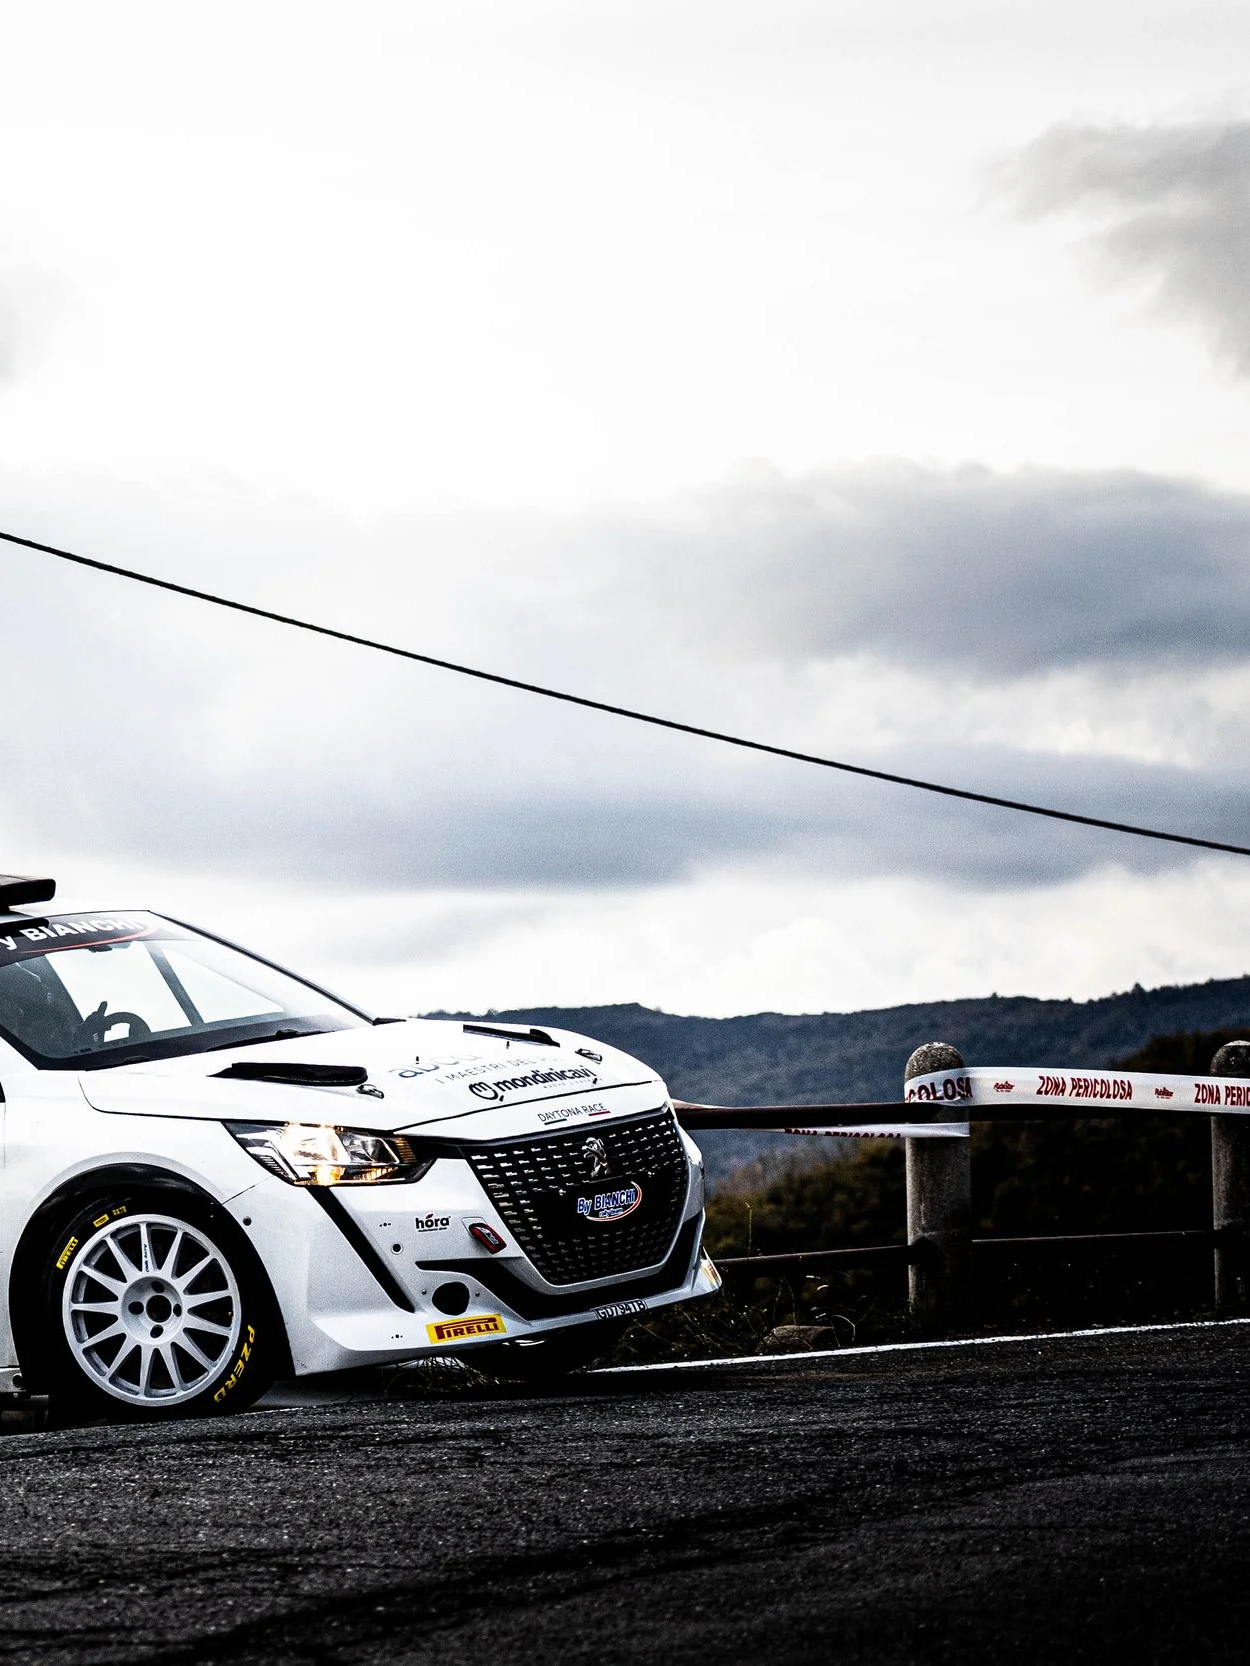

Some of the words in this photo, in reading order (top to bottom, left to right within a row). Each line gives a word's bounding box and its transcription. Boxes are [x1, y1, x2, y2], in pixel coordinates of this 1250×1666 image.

[493, 1065, 598, 1092] mondinicavi
[1036, 1075, 1067, 1097] ZONA
[1070, 1077, 1133, 1101] PERICOLOSA
[1194, 1083, 1221, 1105] ZONA
[537, 1106, 582, 1122] DAYTONA
[581, 1103, 607, 1115] RACE
[577, 1197, 592, 1216] By
[594, 1188, 636, 1210] BIANCHI
[55, 1236, 79, 1270] PIRELLI
[434, 1317, 499, 1341] PIRELLI
